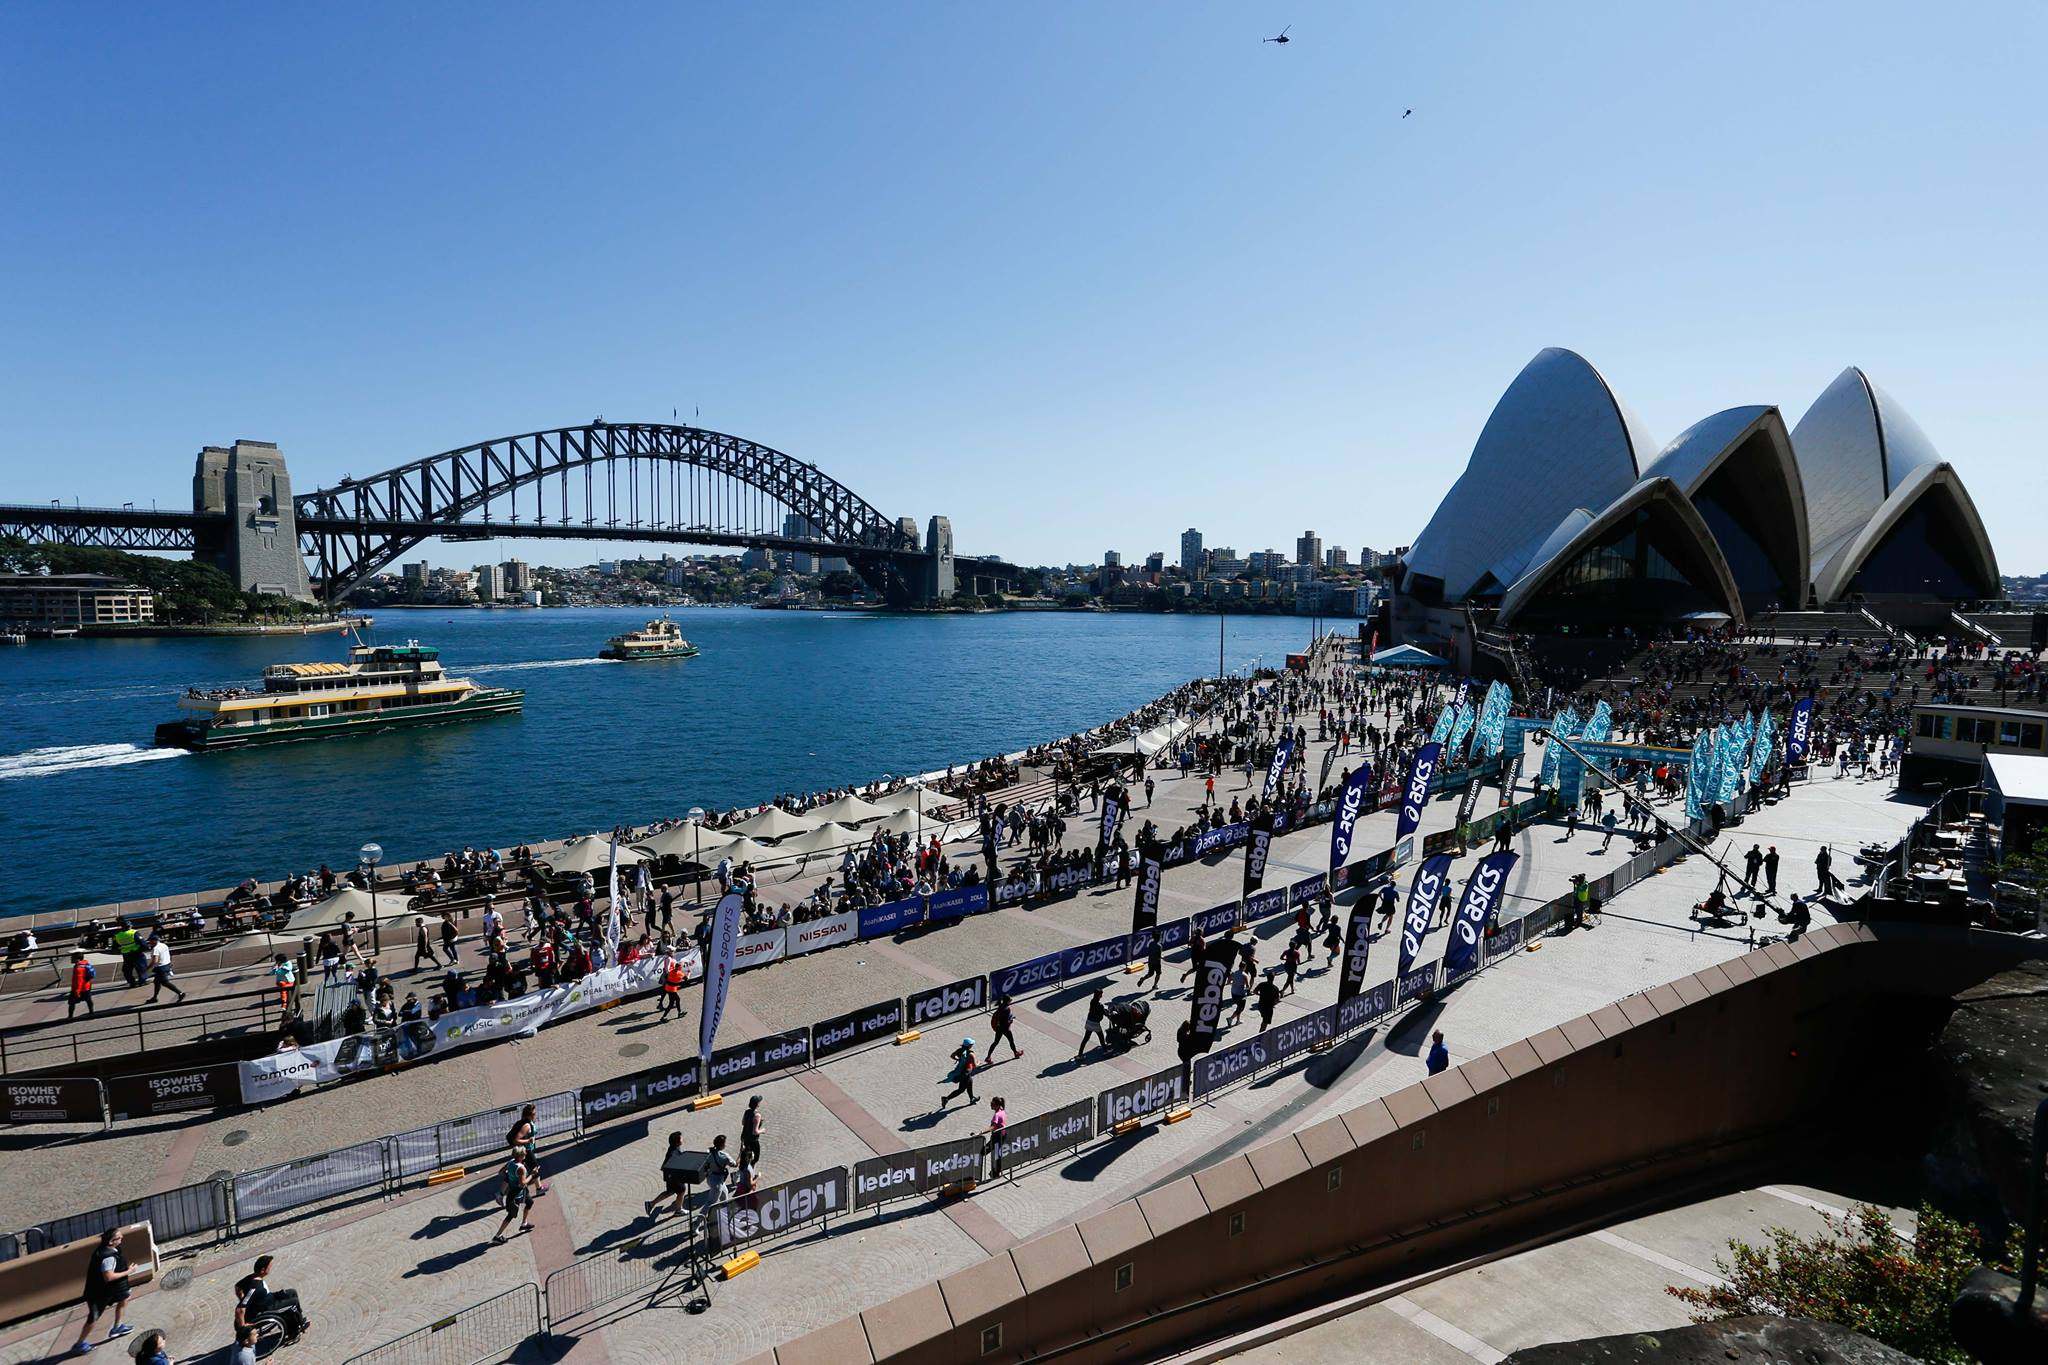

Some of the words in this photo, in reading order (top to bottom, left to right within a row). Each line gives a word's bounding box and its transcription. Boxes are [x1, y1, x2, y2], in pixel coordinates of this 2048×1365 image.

[1249, 829, 1270, 879] rebel
[1051, 863, 1092, 888] rebel
[1142, 858, 1161, 914] rebel
[903, 907, 919, 917] ZOLL
[720, 906, 734, 960] SPORTS
[736, 940, 774, 958] SSAN
[799, 922, 848, 944] NISSAN
[1347, 915, 1371, 983] rebel
[914, 979, 981, 1023] rebel
[1195, 960, 1227, 1034] rebel
[815, 1022, 855, 1049] rebel
[861, 1008, 899, 1033] rebel
[711, 1053, 756, 1079] rebel
[764, 1037, 807, 1063] rebel
[8, 1086, 62, 1096] ISOWHEY
[14, 1096, 58, 1106] SPORTS
[149, 1072, 209, 1089] ISOWHEY
[156, 1082, 204, 1098] SPORTS
[584, 1084, 637, 1115] rebel
[647, 1067, 696, 1096] rebel
